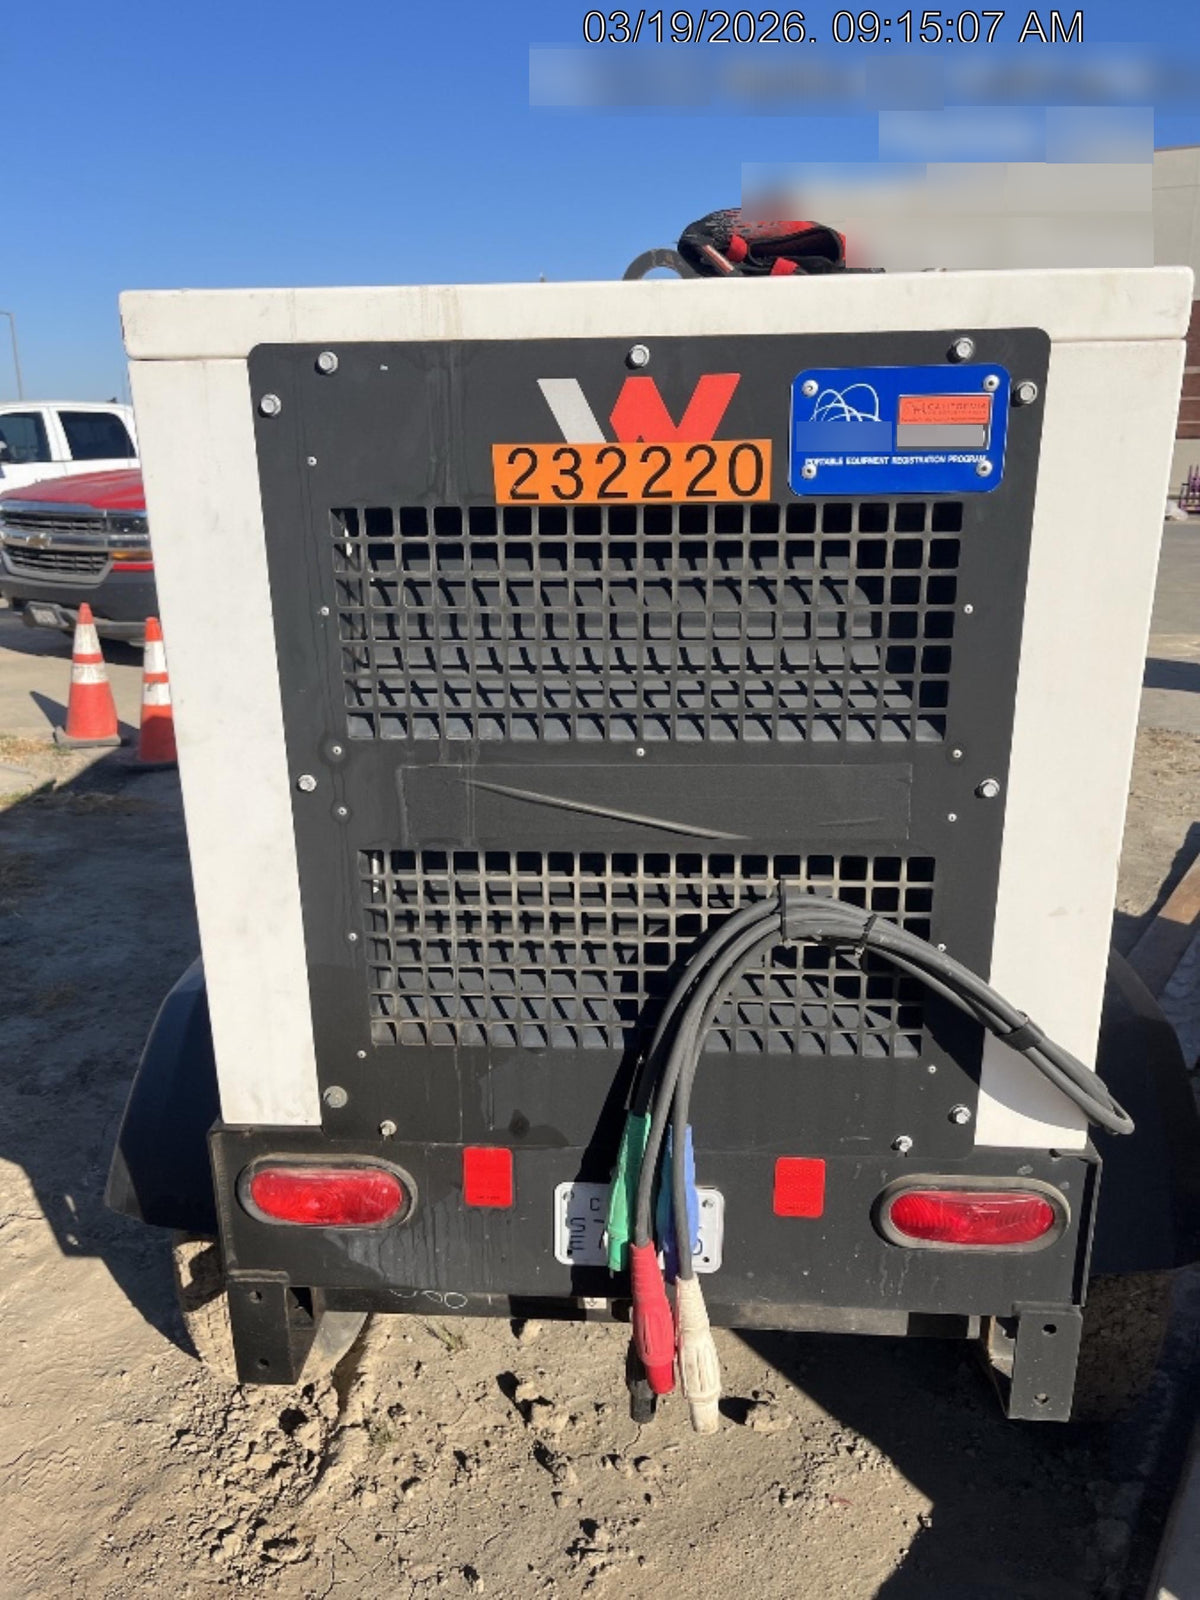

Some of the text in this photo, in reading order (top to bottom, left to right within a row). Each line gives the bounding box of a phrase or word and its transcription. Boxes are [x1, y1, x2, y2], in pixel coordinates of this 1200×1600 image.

[506, 443, 764, 501] 232220
[846, 457, 890, 465] EQUIPMENT
[892, 456, 946, 464] REGISTRATION
[948, 455, 987, 463] PROGRAM
